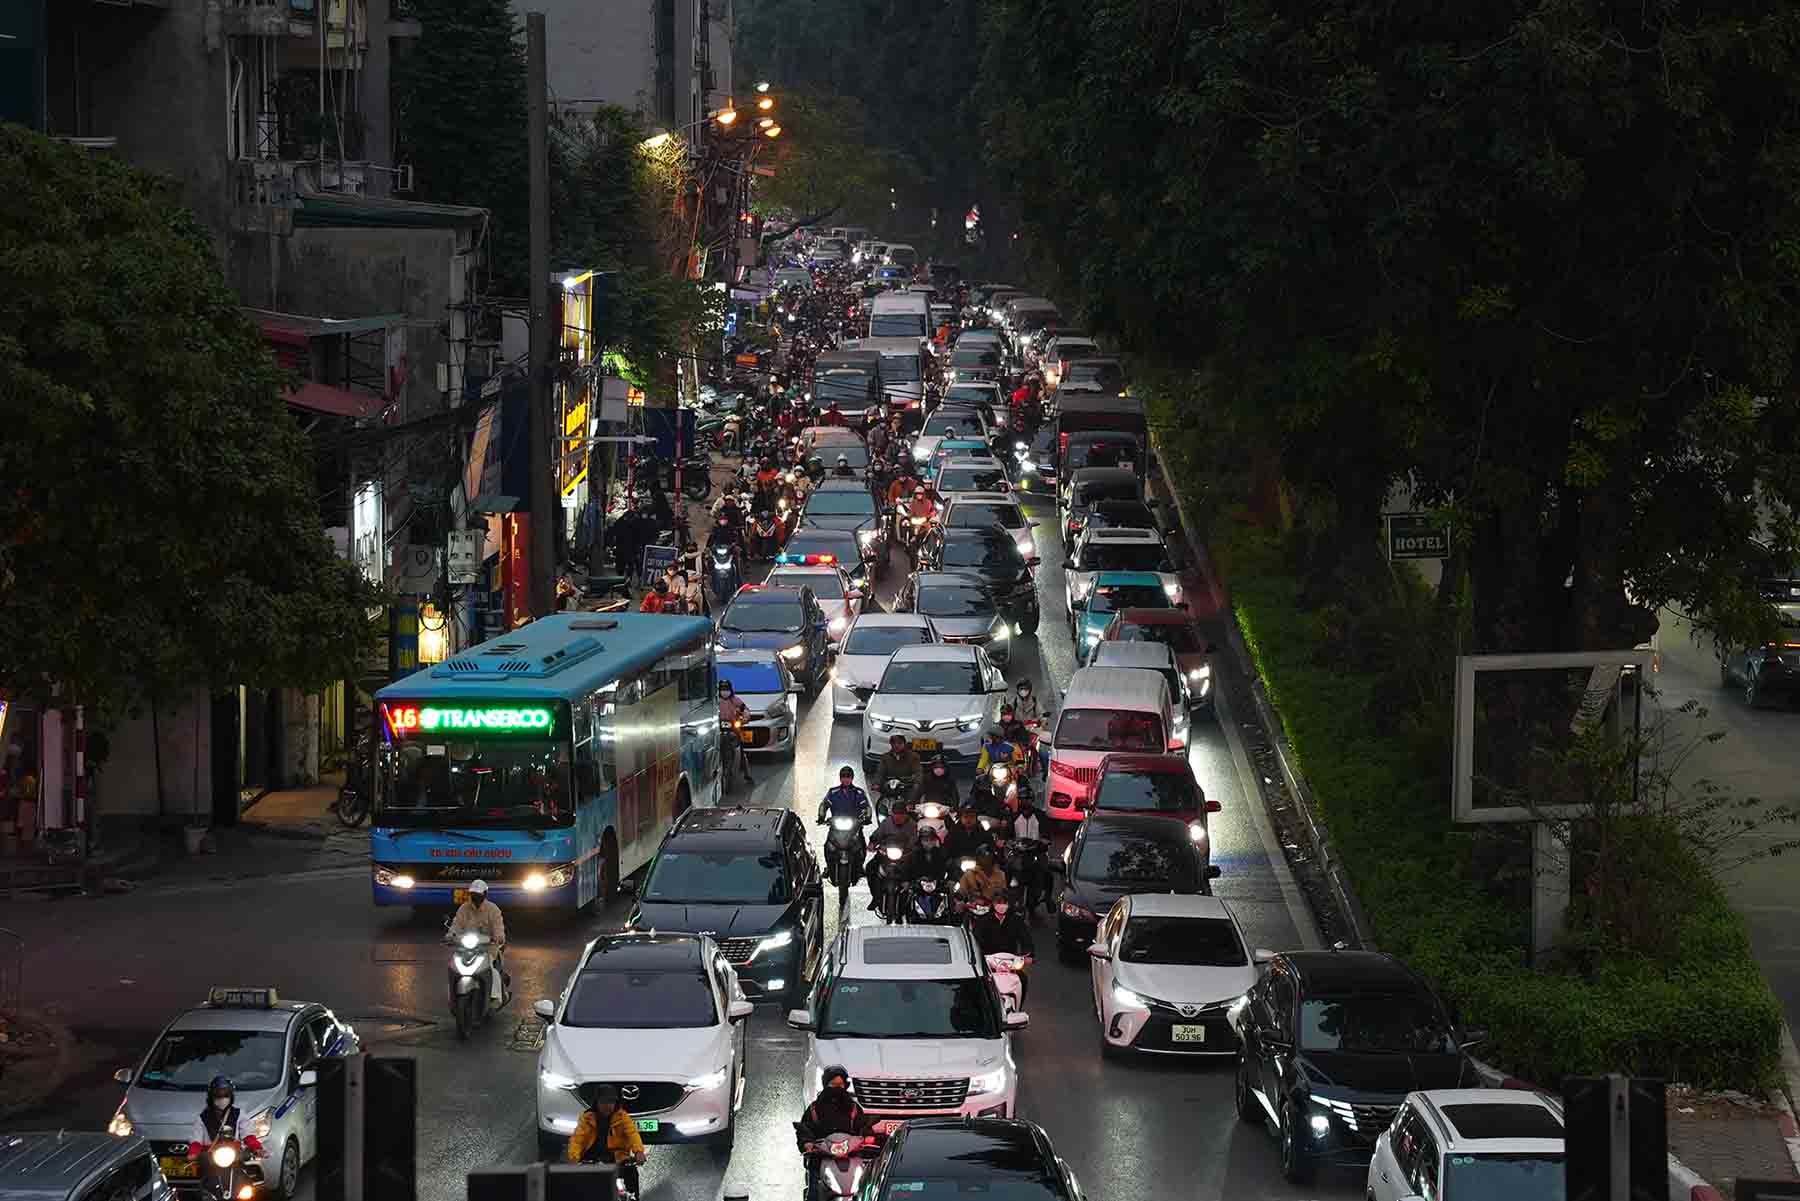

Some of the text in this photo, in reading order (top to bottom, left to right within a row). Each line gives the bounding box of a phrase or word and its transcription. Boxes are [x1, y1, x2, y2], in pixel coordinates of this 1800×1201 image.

[1394, 537, 1445, 551] HOTEL
[393, 708, 550, 728] 16 TRANSERCO
